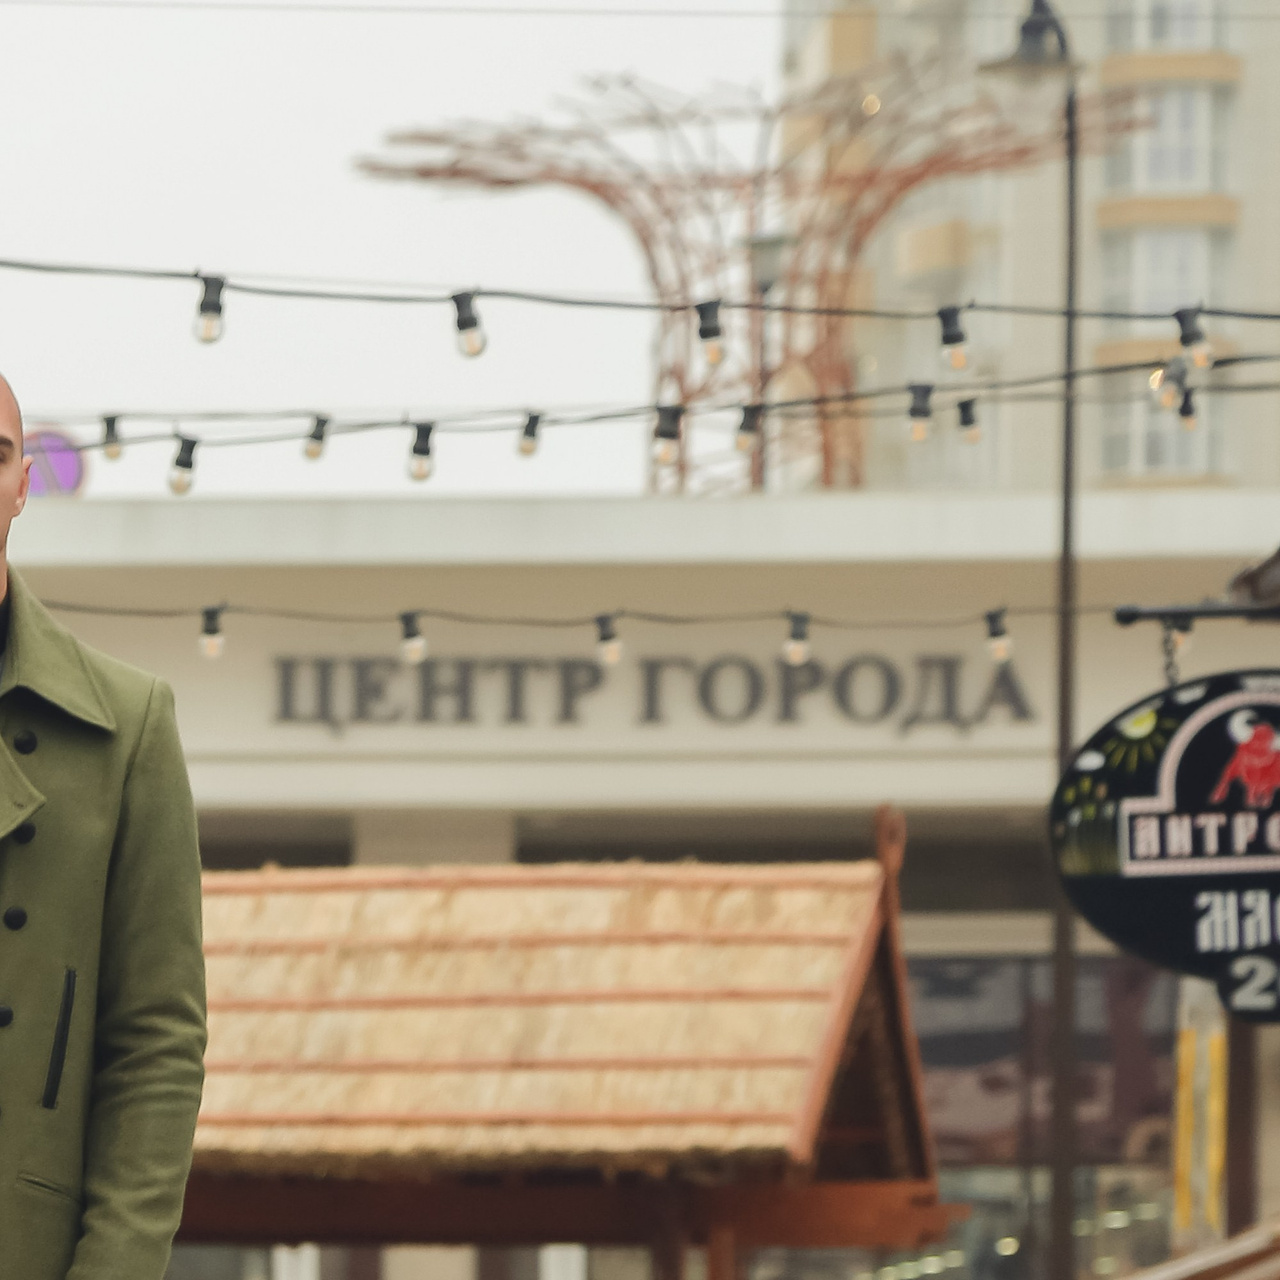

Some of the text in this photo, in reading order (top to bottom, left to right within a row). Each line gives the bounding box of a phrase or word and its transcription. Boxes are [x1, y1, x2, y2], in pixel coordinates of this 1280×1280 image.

[273, 652, 1036, 739] ЦЕНТР ГОРОДА
[1231, 956, 1280, 1011] 2
